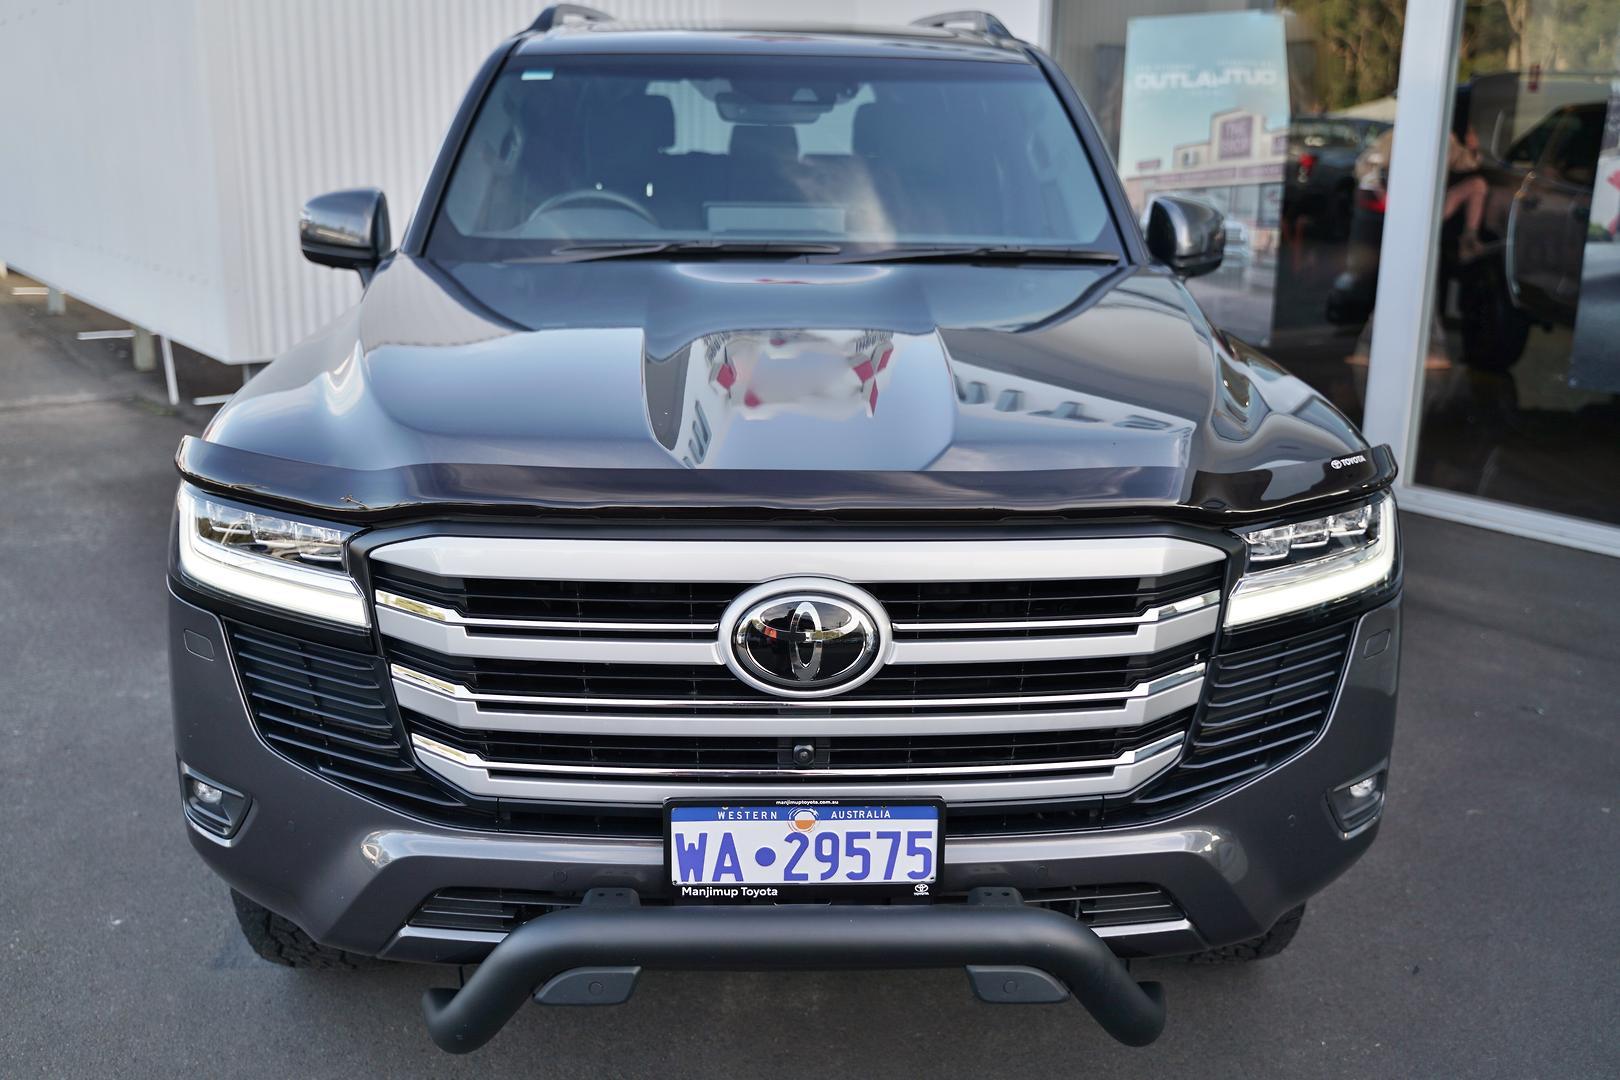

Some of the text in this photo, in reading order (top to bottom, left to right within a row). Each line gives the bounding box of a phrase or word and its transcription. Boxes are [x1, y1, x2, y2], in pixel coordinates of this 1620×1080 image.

[1340, 455, 1366, 466] TOYOTA
[717, 810, 891, 820] WESTERN AUSTRALIA
[681, 886, 778, 898] Manjimup Toyota
